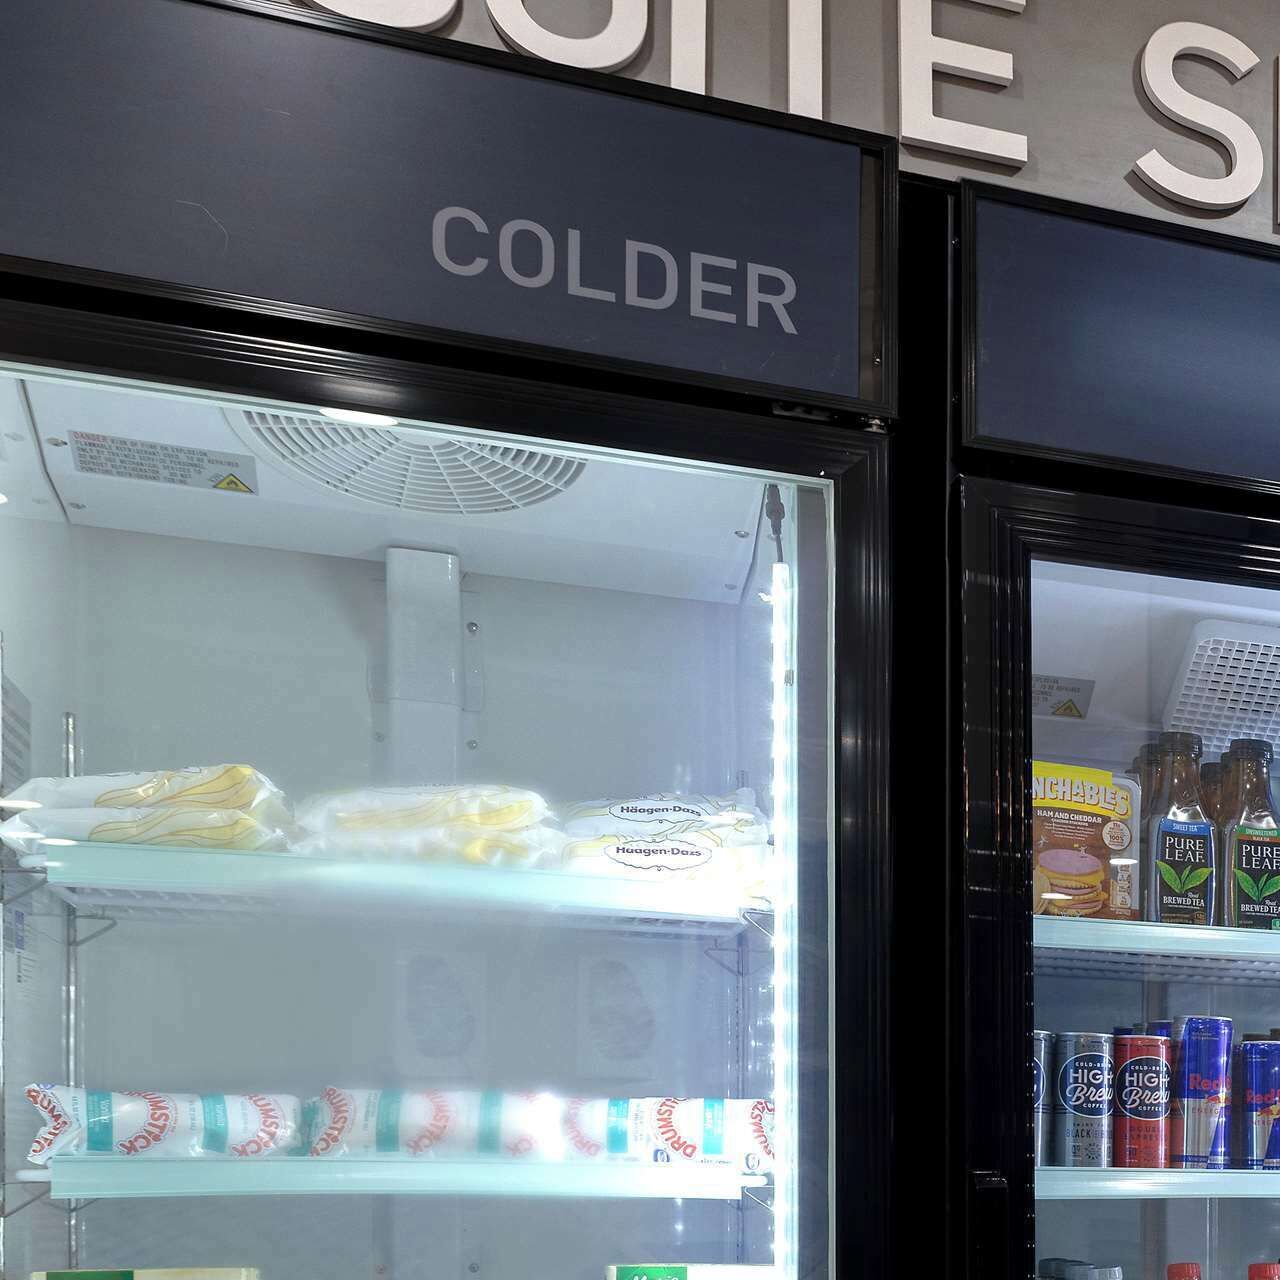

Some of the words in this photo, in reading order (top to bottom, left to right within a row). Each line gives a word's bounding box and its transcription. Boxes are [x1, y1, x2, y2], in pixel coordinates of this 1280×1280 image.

[431, 205, 799, 334] COLDER
[1033, 776, 1130, 816] NCHABLES
[1038, 810, 1053, 818] HAM
[1054, 811, 1069, 820] AND
[1070, 813, 1102, 824] CHEDDAR
[1166, 837, 1204, 851] PURE
[1163, 896, 1192, 906] BREWED
[1192, 899, 1205, 907] TEA
[1241, 904, 1268, 913] BREWED
[1069, 1069, 1113, 1084] HIGH
[1126, 1072, 1170, 1087] HIGH
[1066, 1084, 1113, 1105] Brew
[1122, 1087, 1170, 1108] Brew
